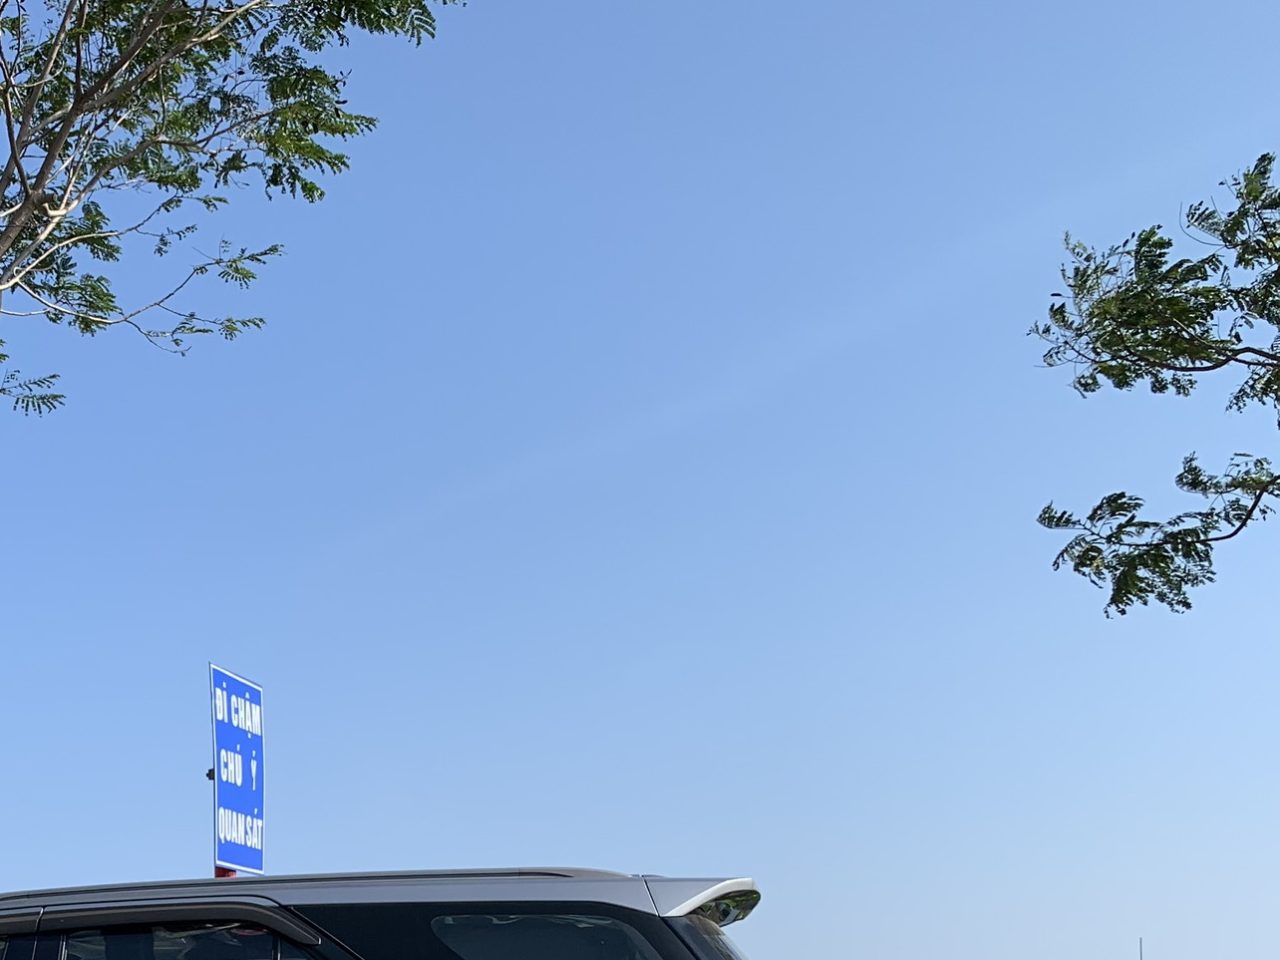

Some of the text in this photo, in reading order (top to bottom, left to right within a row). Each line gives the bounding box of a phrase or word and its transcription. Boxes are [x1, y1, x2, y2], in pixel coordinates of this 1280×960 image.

[231, 691, 261, 739] CHẬM
[220, 744, 257, 791] CHÚ Ý
[218, 806, 263, 851] QUAN SÁT
